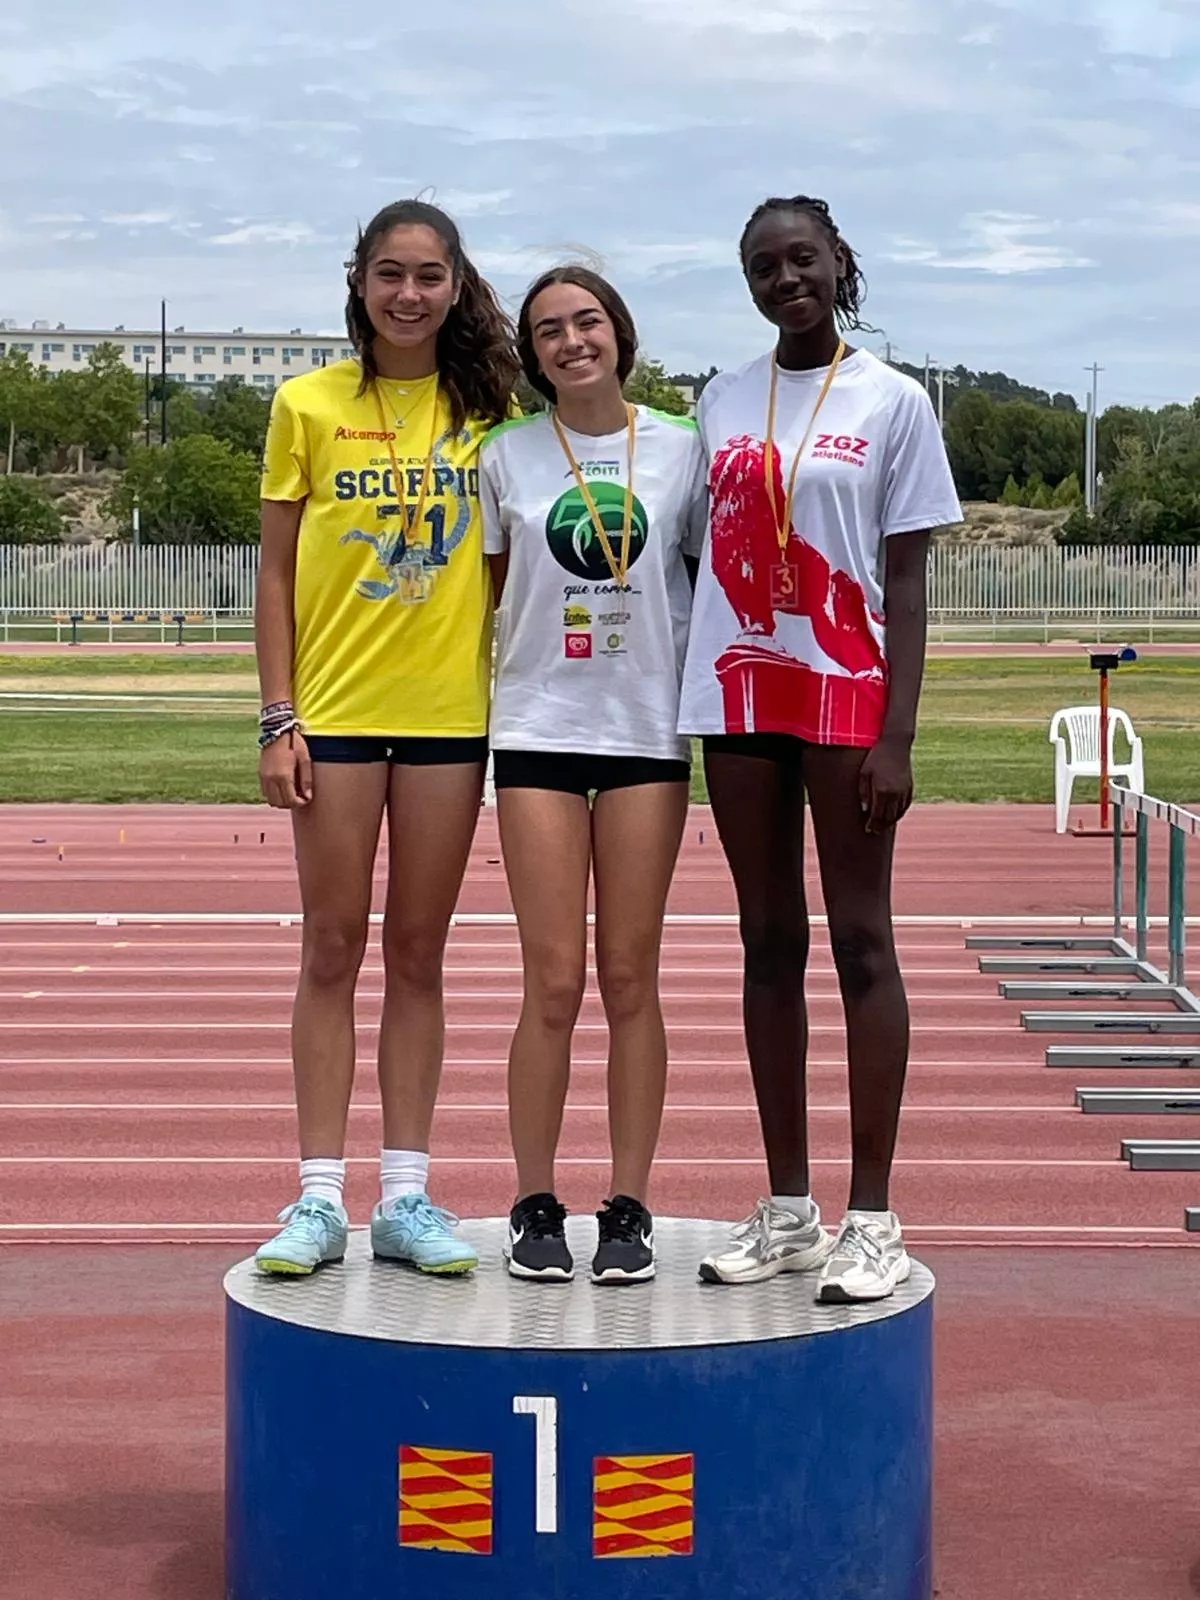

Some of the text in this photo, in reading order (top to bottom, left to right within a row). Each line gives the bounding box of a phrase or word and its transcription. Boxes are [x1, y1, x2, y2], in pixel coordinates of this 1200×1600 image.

[814, 434, 869, 456] ZGZ
[776, 567, 794, 594] 3
[563, 585, 589, 601] que
[513, 1396, 557, 1532] 1
